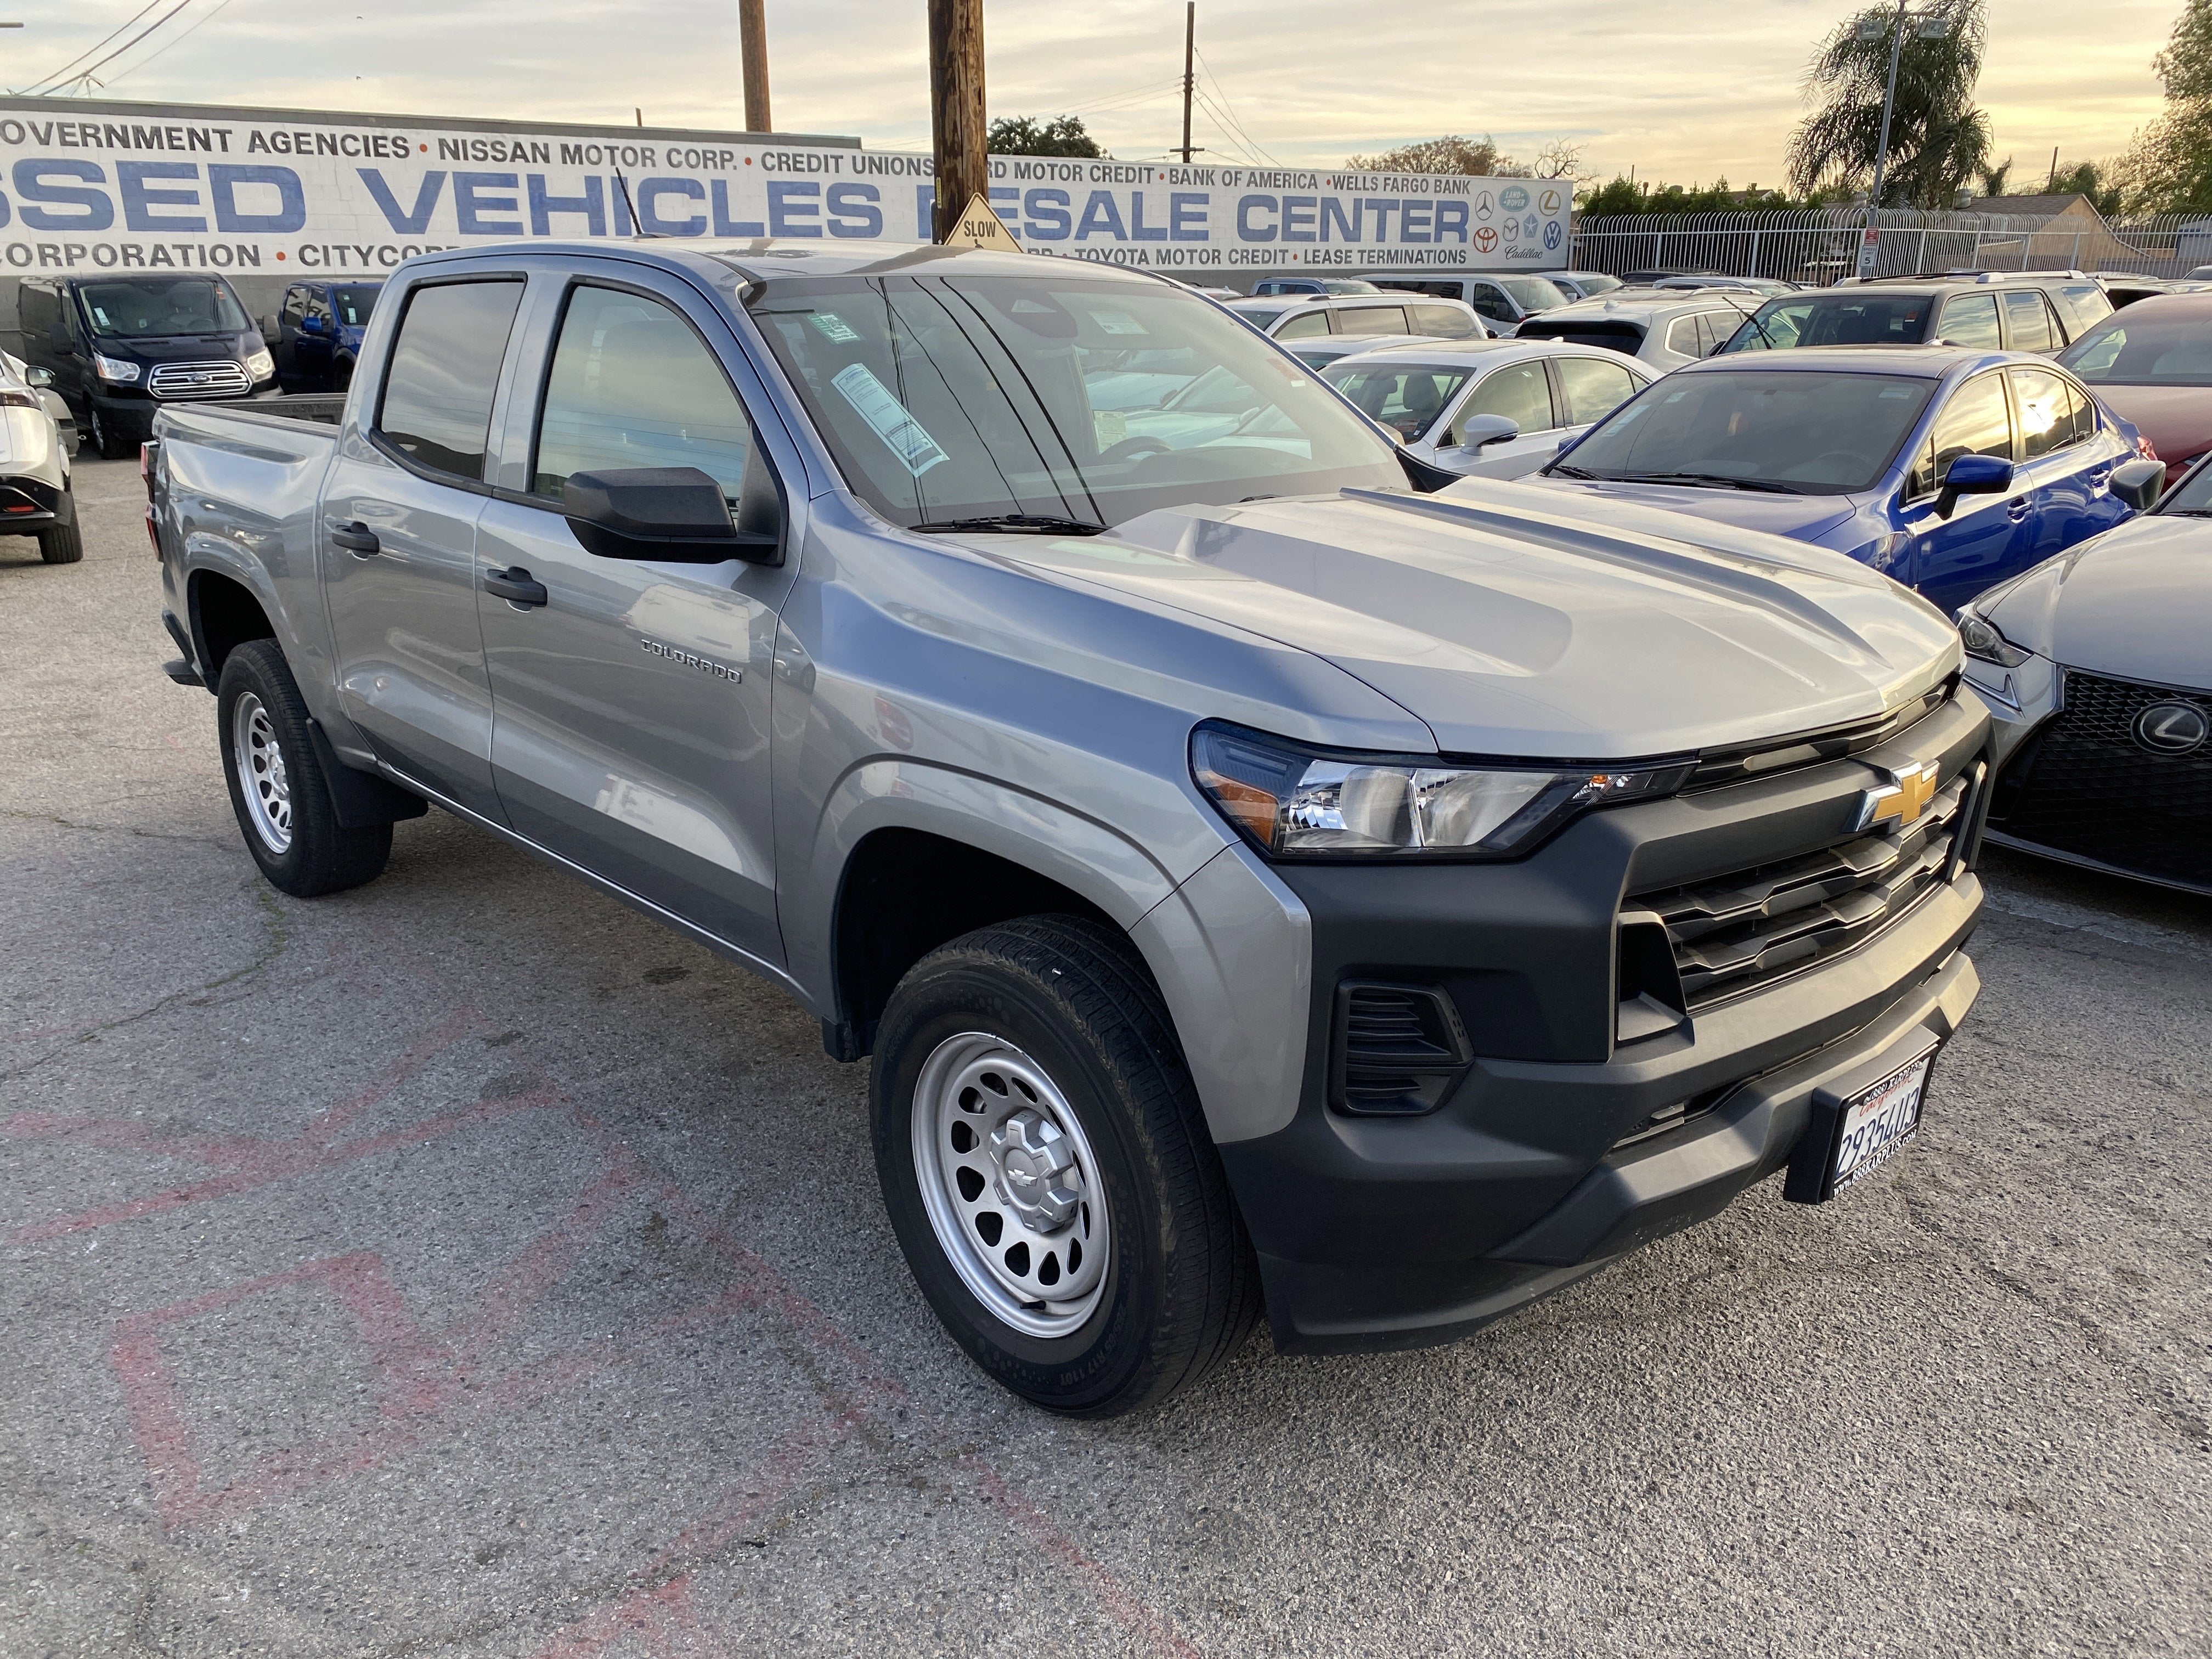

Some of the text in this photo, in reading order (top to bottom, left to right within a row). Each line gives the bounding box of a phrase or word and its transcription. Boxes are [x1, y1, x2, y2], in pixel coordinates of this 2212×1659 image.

[247, 129, 411, 159] AGENCIES
[438, 137, 550, 165] NISSAN
[560, 143, 656, 168] MOTOR
[665, 148, 738, 171] CORP.
[760, 151, 844, 174] CREDIT
[851, 154, 934, 177] UNIONS
[1014, 161, 1083, 183] MOTOR
[1089, 164, 1155, 184] CREDIT
[1169, 167, 1215, 187] BANK
[1221, 169, 1242, 187] OF
[1246, 170, 1318, 190] AMERICA
[1331, 174, 1379, 193] WELLS
[1383, 177, 1429, 194] FARGO
[1433, 179, 1471, 195] BANK
[0, 157, 307, 233] SED
[356, 167, 883, 239] VEHICLES
[1237, 194, 1469, 243] CENTER
[1505, 190, 1520, 199] LAND
[1505, 199, 1525, 207] ROVER
[963, 220, 996, 238] SLOW
[0, 242, 1466, 268] ORPORATION CITYCO TOYOTA MOTOR CREDIT LEASE TERMINATIONS
[1504, 245, 1543, 260] Cadillac
[640, 638, 742, 684] COLORADO
[1835, 1086, 1920, 1178] 29354U3
